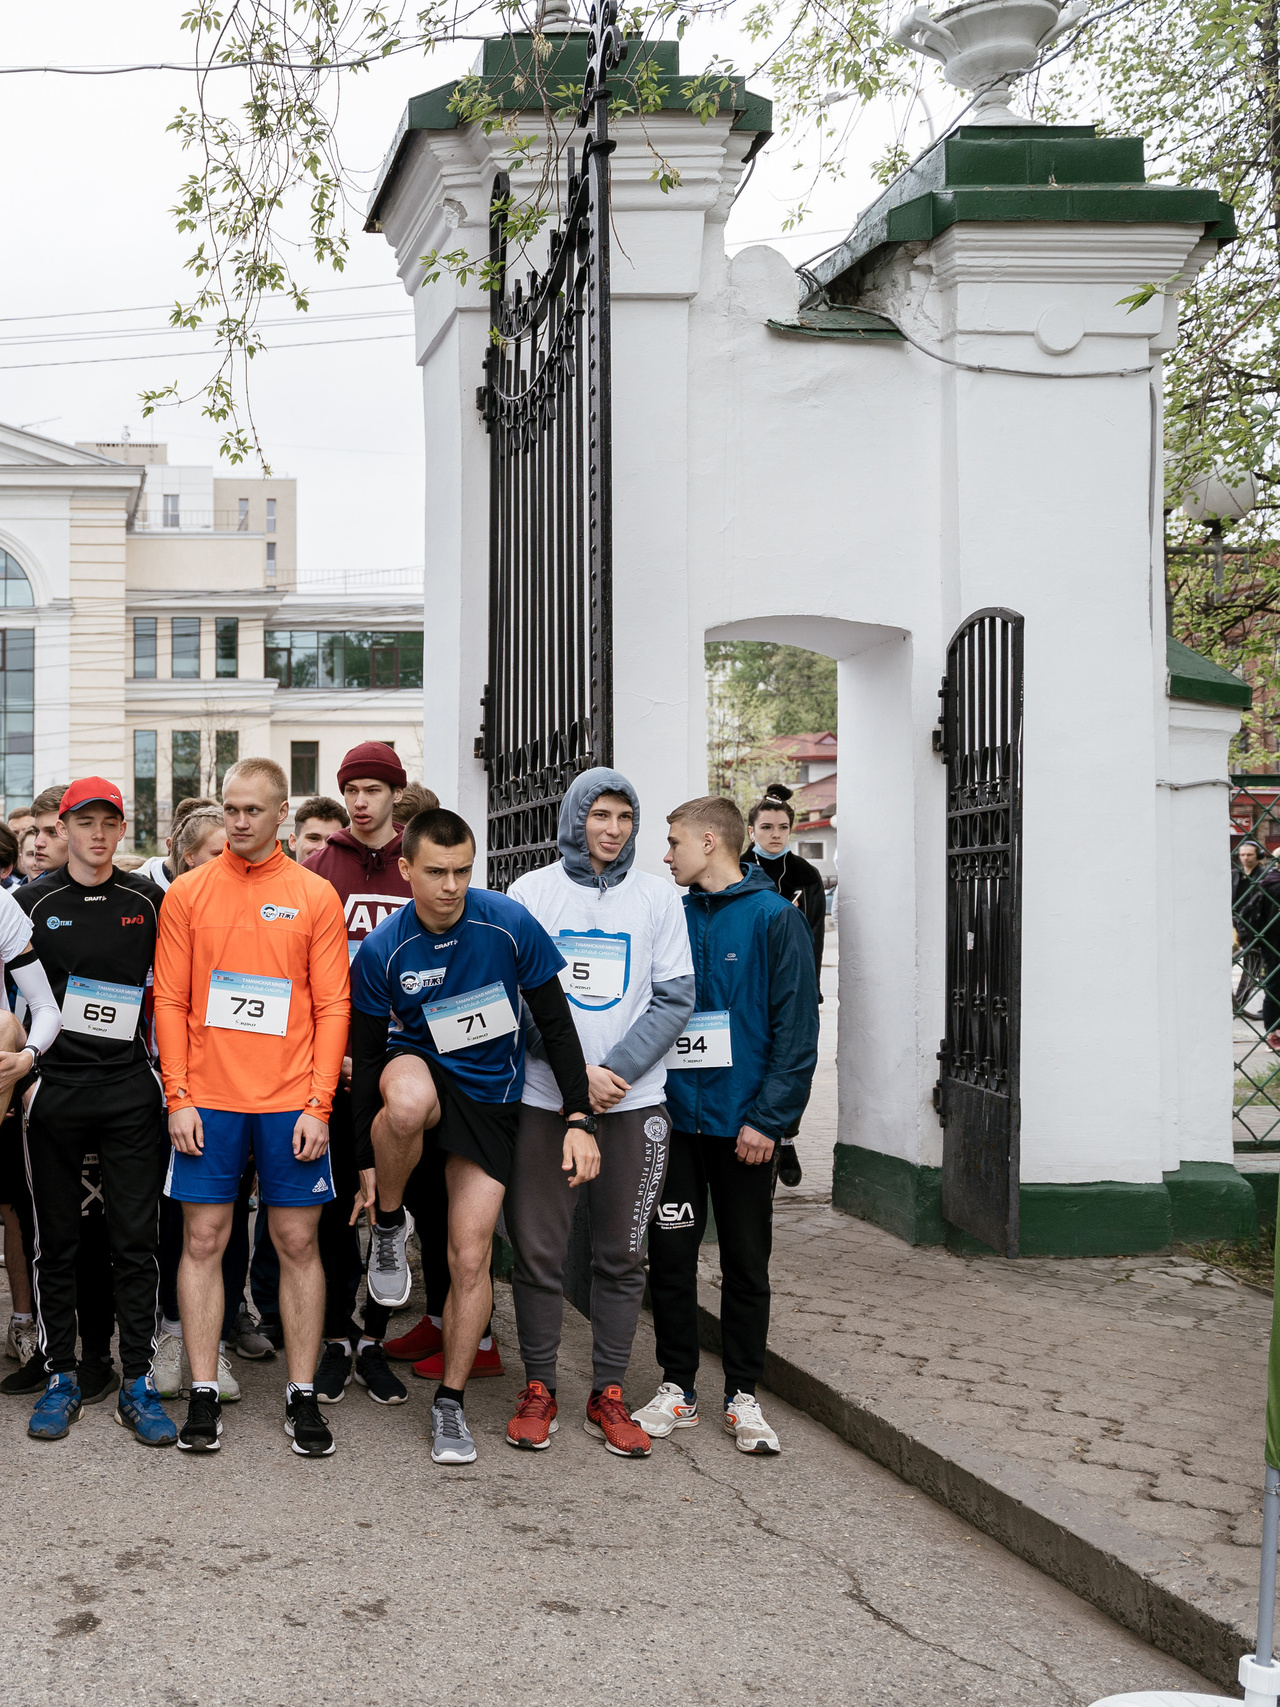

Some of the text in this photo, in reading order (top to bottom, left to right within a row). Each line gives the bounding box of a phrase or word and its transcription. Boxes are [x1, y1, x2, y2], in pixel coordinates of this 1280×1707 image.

[572, 962, 590, 980] 5
[83, 1003, 117, 1024] 69
[230, 996, 265, 1018] 73
[457, 1012, 487, 1034] 71
[676, 1036, 708, 1054] 94
[638, 1168, 650, 1196] FITCH
[632, 1201, 641, 1221] NEW
[629, 1226, 638, 1252] YORK
